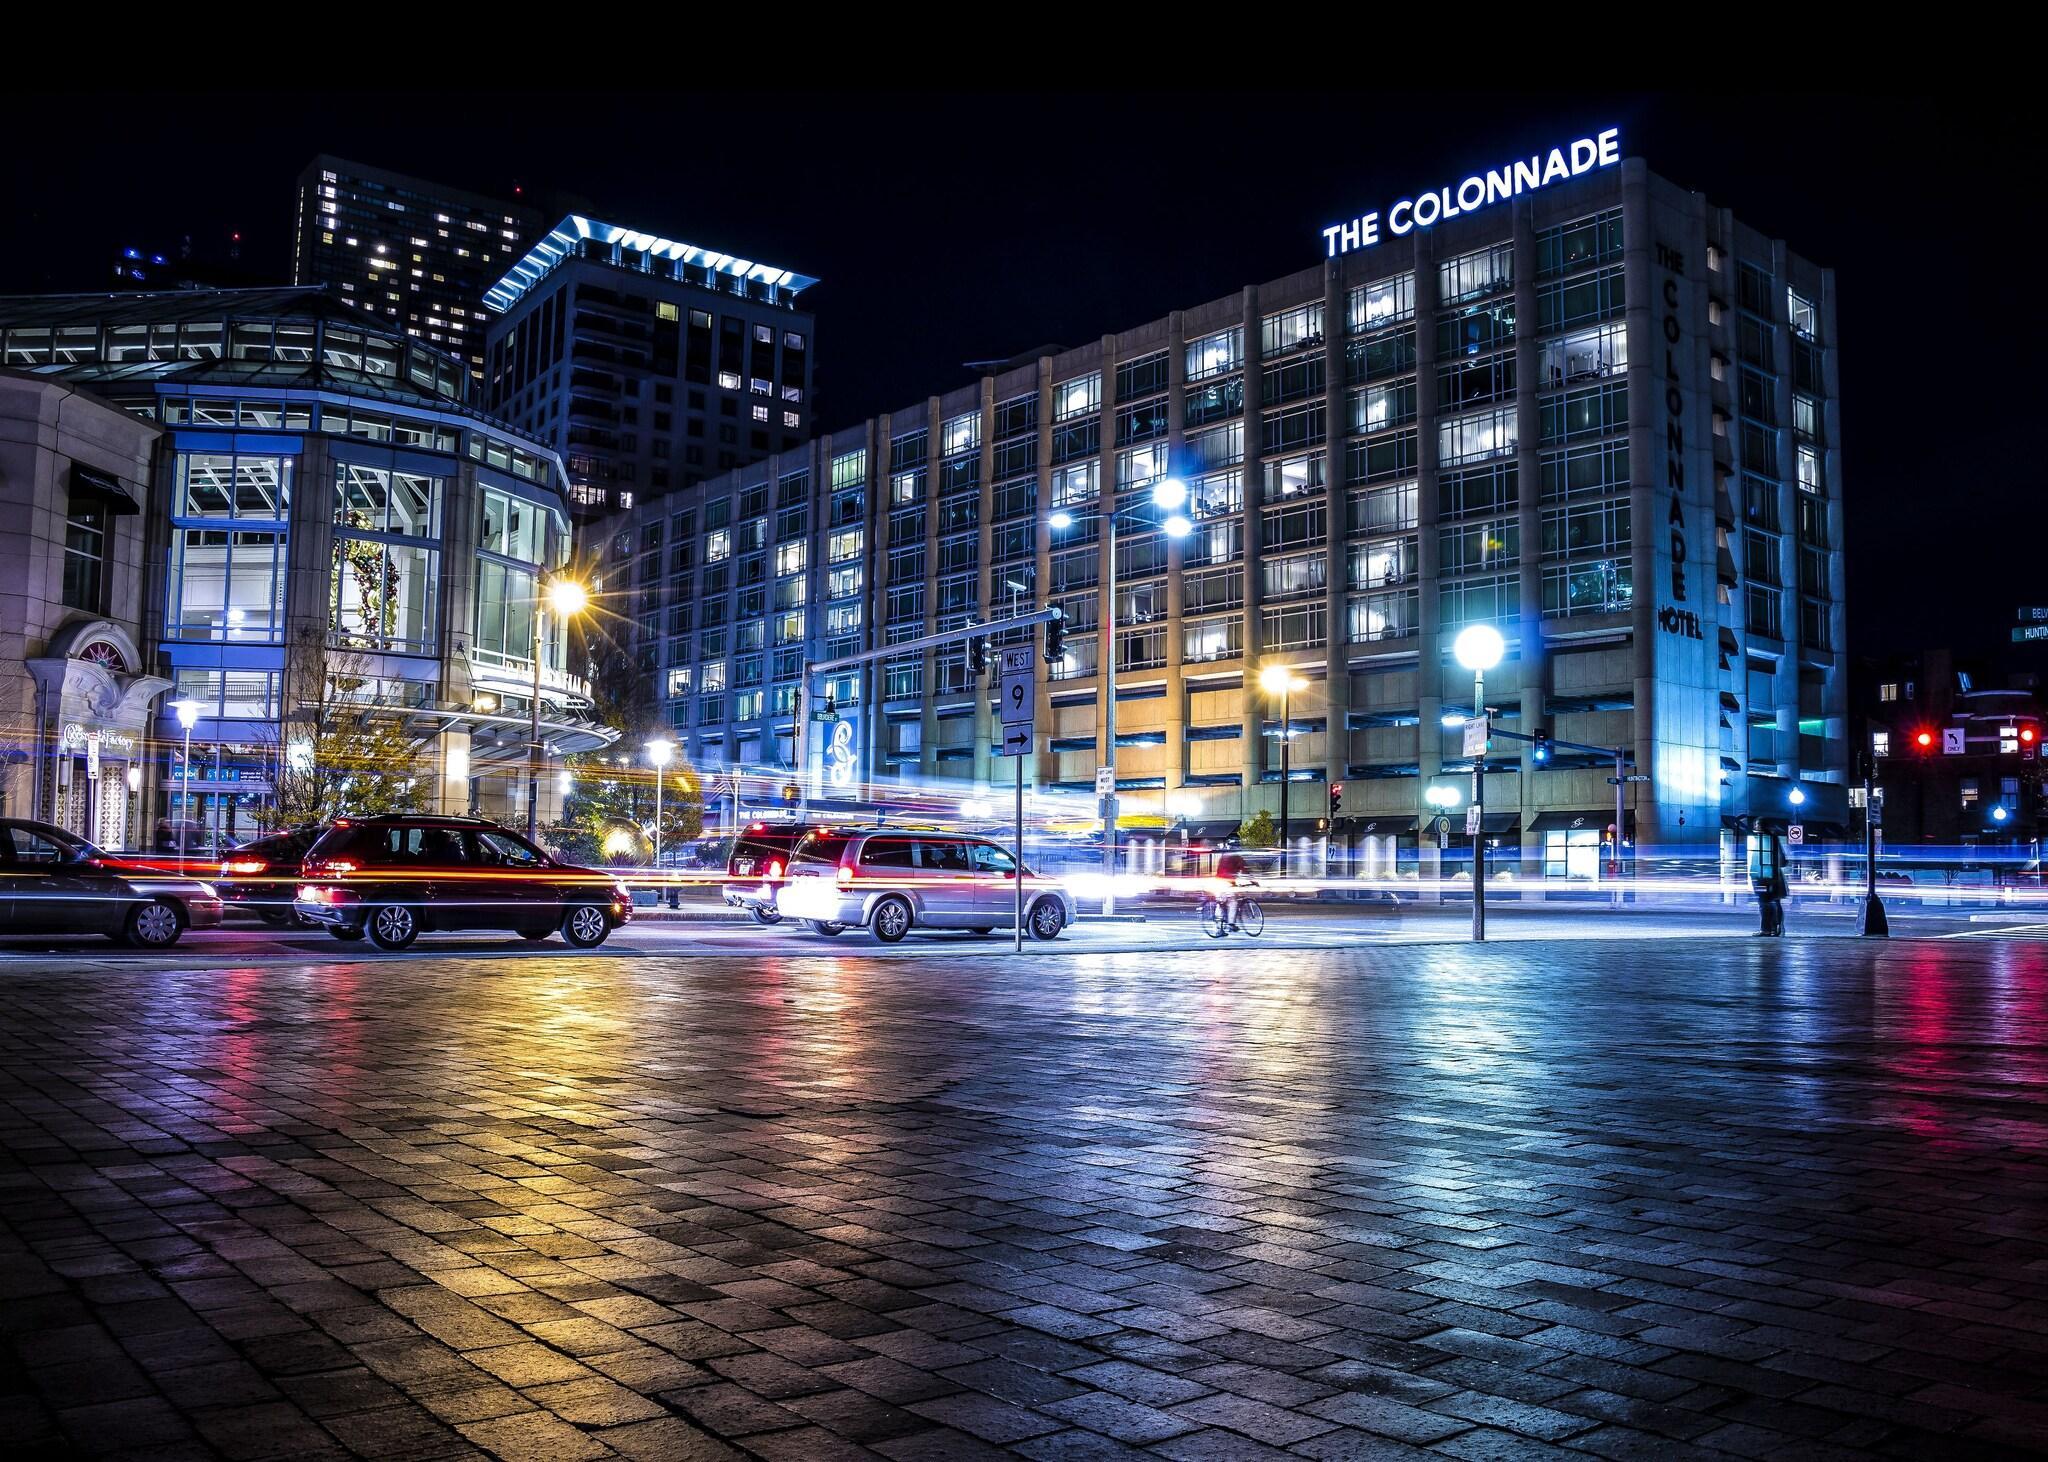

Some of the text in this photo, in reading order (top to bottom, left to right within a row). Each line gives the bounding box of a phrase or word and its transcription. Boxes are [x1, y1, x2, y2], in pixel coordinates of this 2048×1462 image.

[1323, 128, 1619, 257] THE COLONNADE
[1655, 242, 1684, 276] THE
[1663, 279, 1686, 601] COLONNADE
[1658, 604, 1703, 640] HOTEL
[1006, 652, 1030, 667] WEST
[1012, 684, 1024, 710] 9
[106, 730, 133, 750] Factory
